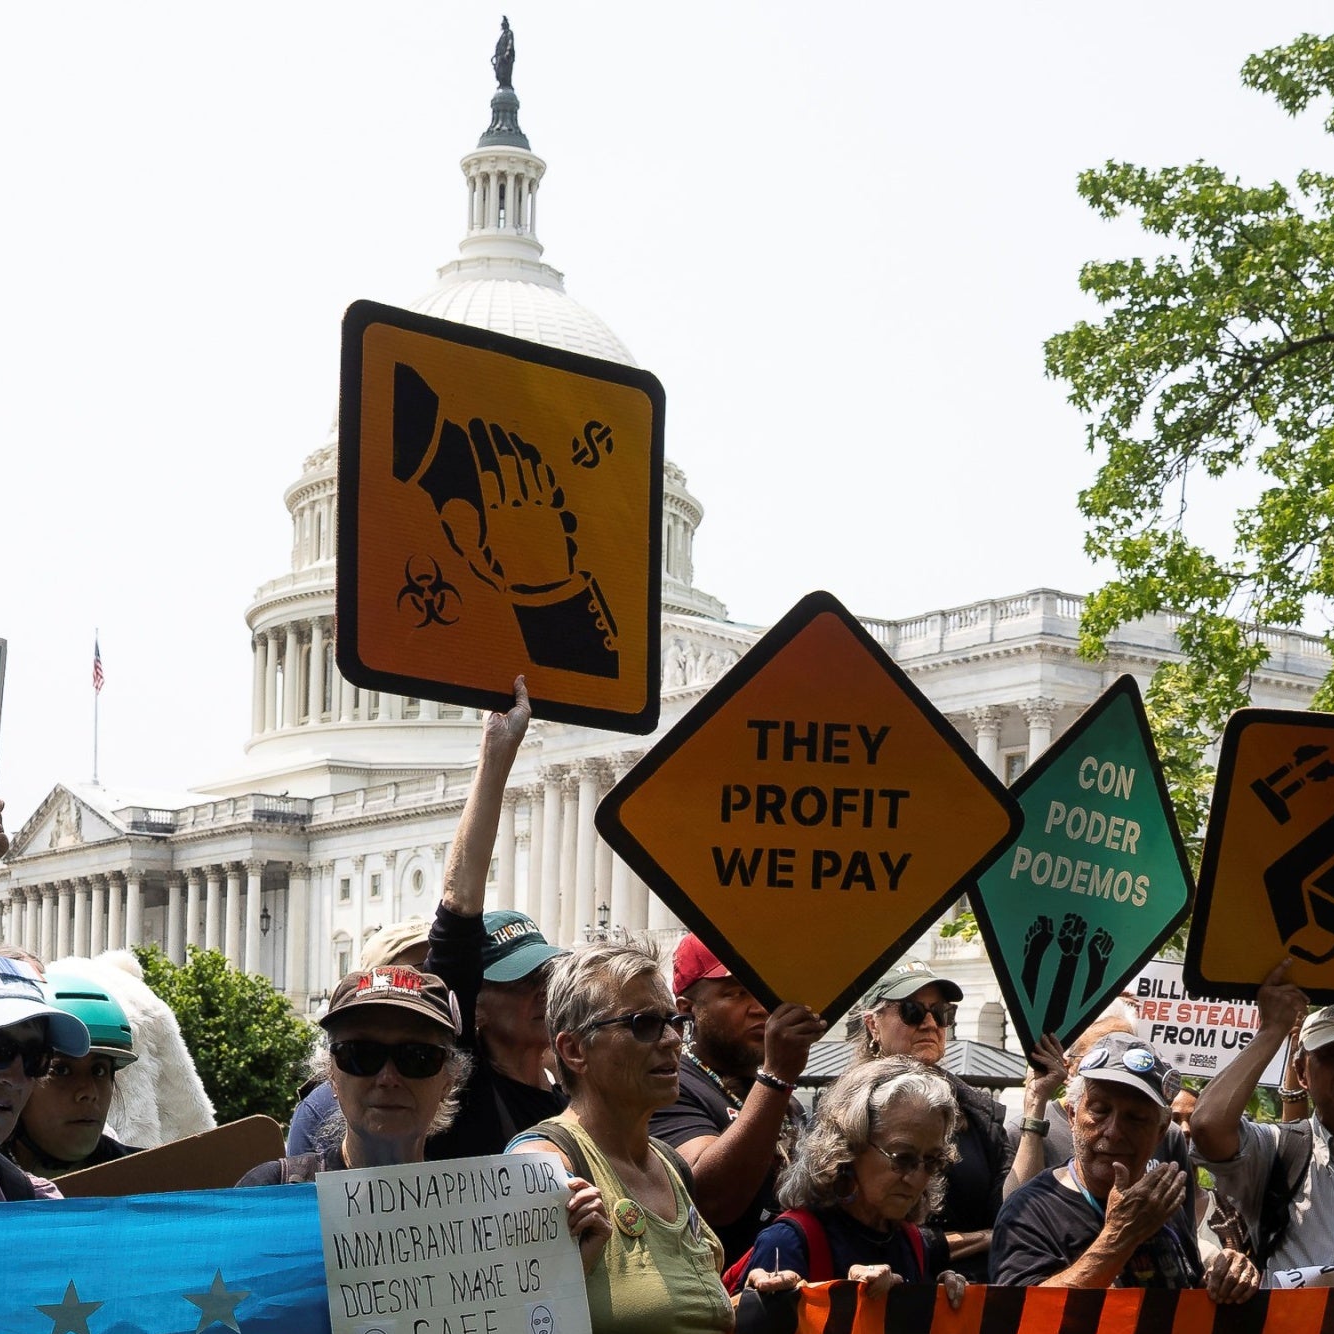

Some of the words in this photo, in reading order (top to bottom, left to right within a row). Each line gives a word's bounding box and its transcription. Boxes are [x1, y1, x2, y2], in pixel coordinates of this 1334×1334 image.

[747, 720, 891, 766] THEY
[1078, 756, 1136, 801] CON
[721, 785, 910, 829] PROFIT
[1044, 801, 1141, 855] PODER
[711, 847, 796, 888] WE
[810, 850, 913, 892] PAY
[1009, 845, 1151, 908] PODEMOS
[1150, 1024, 1216, 1048] FROM
[1222, 1030, 1253, 1050] US
[1177, 1003, 1260, 1029] STEALI
[345, 1167, 511, 1217] KIDNAPPING
[522, 1162, 560, 1194] OUR
[333, 1220, 464, 1269] IMMIGRANT
[471, 1206, 559, 1253] NEIGHBORS
[340, 1275, 436, 1318] DOESN'T
[449, 1263, 507, 1303] MAKE
[516, 1259, 541, 1293] US
